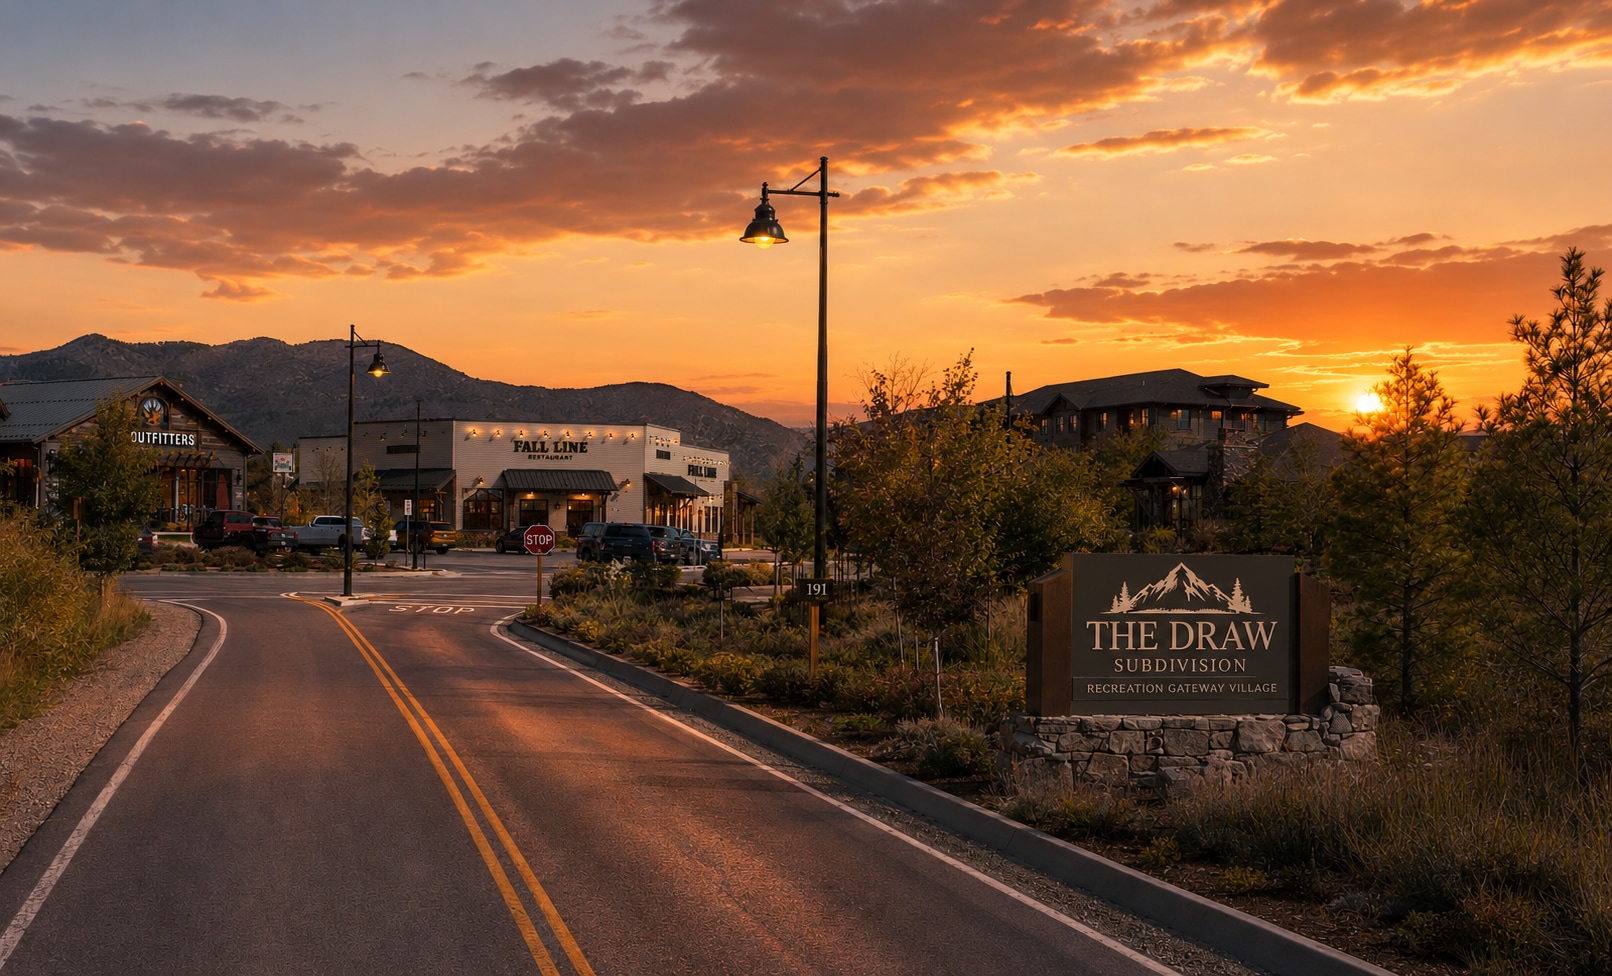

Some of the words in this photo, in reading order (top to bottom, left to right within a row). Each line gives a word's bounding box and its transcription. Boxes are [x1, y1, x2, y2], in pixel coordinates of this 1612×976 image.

[131, 431, 195, 445] OUTFITTERS
[513, 440, 549, 453] FALL
[553, 441, 588, 453] LINE
[526, 534, 553, 545] STOP
[806, 583, 828, 596] 191
[388, 605, 475, 614] STOP
[1086, 621, 1159, 650] THE
[1169, 621, 1278, 650] DRAW
[1114, 658, 1247, 673] SUBDIVISION
[1087, 683, 1164, 694] RECREATION
[1168, 683, 1225, 694] GATEWAY
[1229, 683, 1278, 694] VILLAGE
